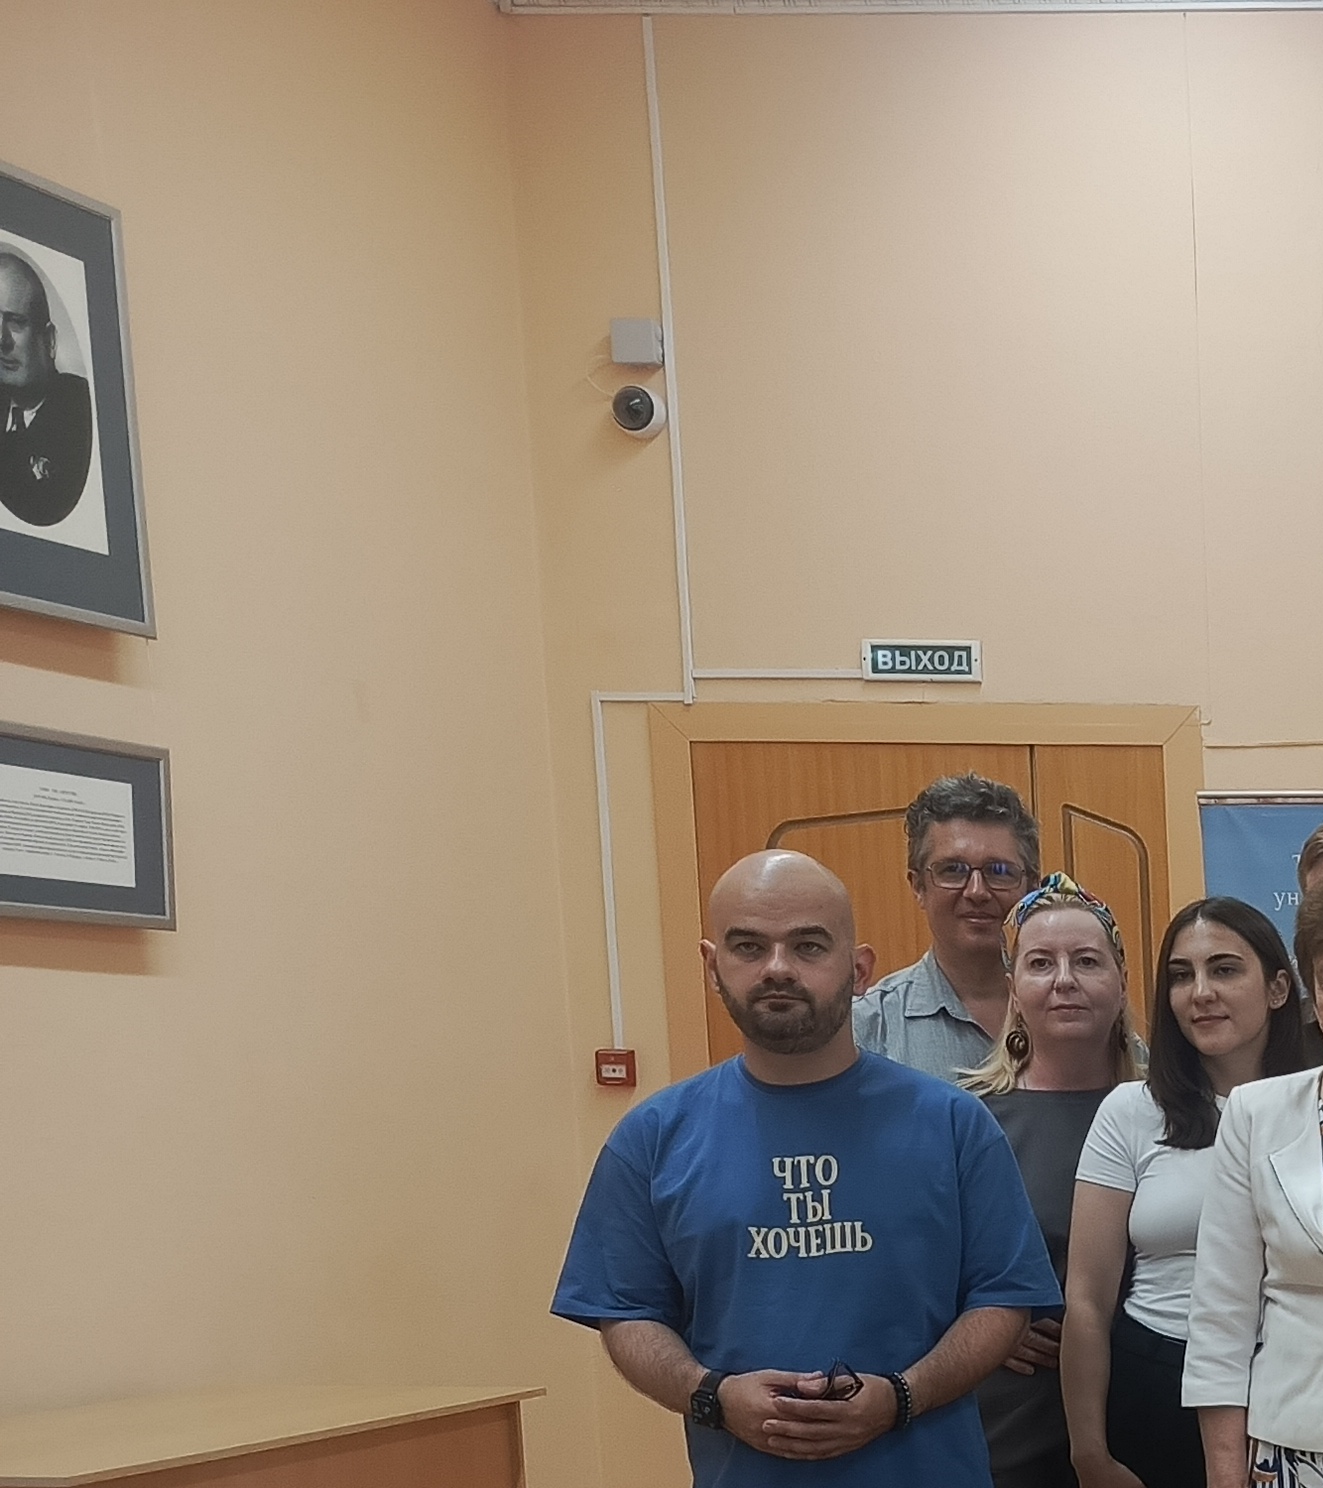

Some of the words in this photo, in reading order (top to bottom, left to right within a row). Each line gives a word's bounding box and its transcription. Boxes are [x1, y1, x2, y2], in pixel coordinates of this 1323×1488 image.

[877, 650, 969, 672] ВЫХОД
[772, 1155, 838, 1189] ЧТО
[783, 1189, 832, 1224] ТЫ
[747, 1221, 873, 1259] ХОЧЕШЬ
